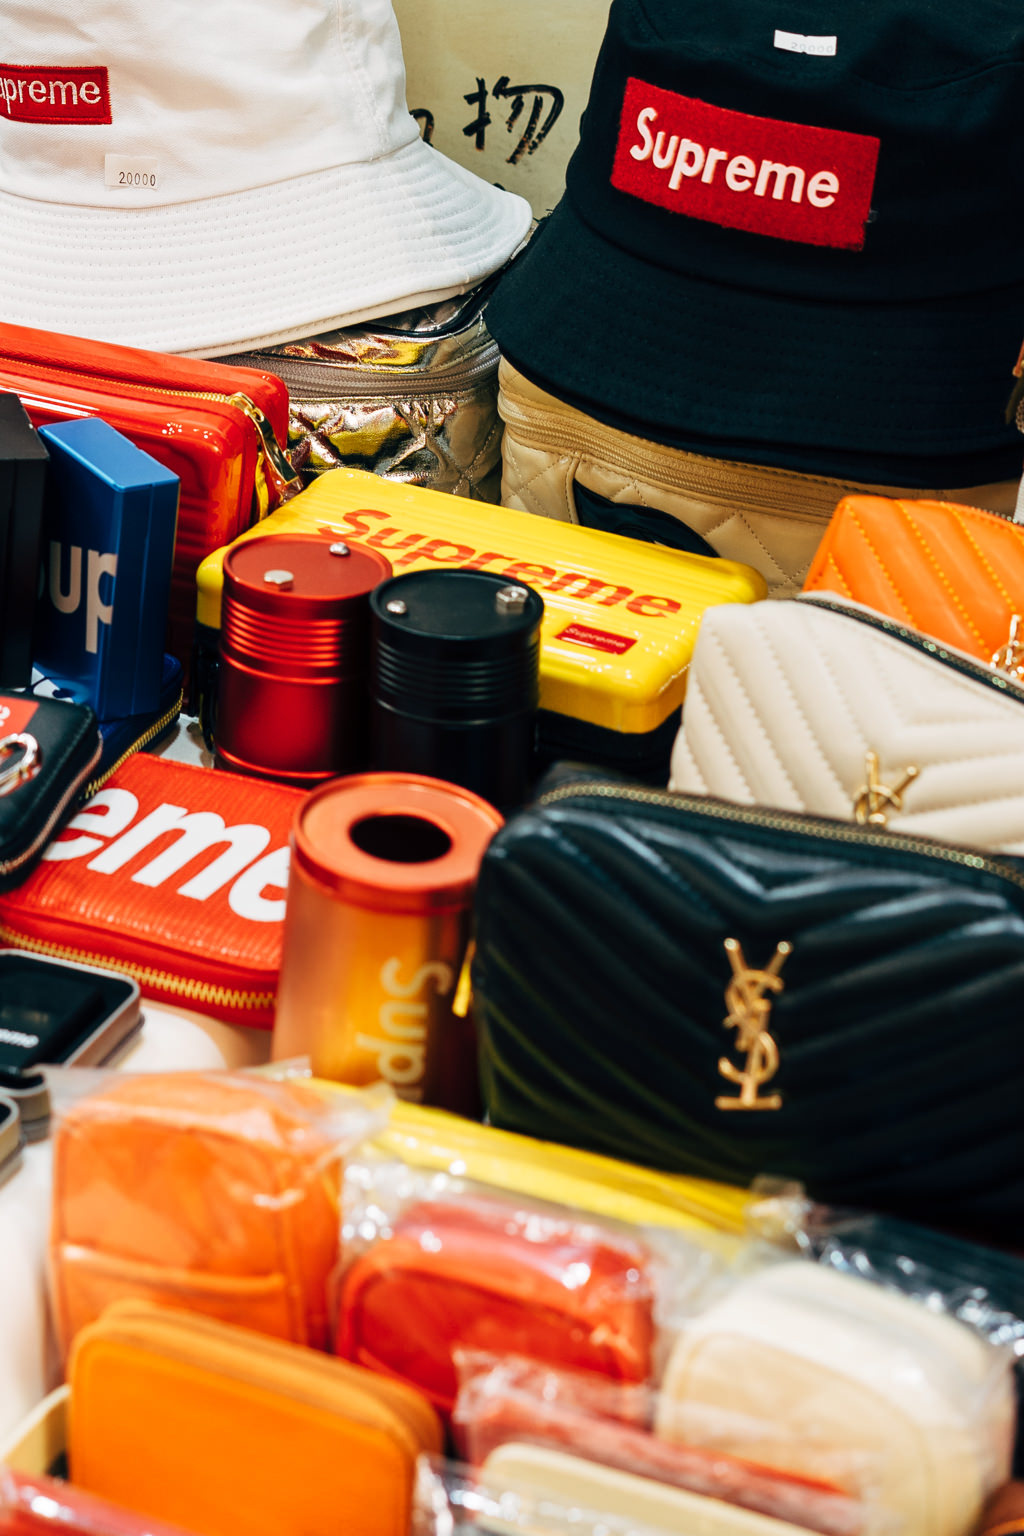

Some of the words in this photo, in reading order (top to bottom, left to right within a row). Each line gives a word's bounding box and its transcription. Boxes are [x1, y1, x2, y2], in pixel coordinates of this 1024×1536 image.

[791, 42, 834, 54] 20000
[629, 106, 840, 208] Supreme
[118, 171, 156, 187] 20000
[565, 628, 626, 648] Supreme
